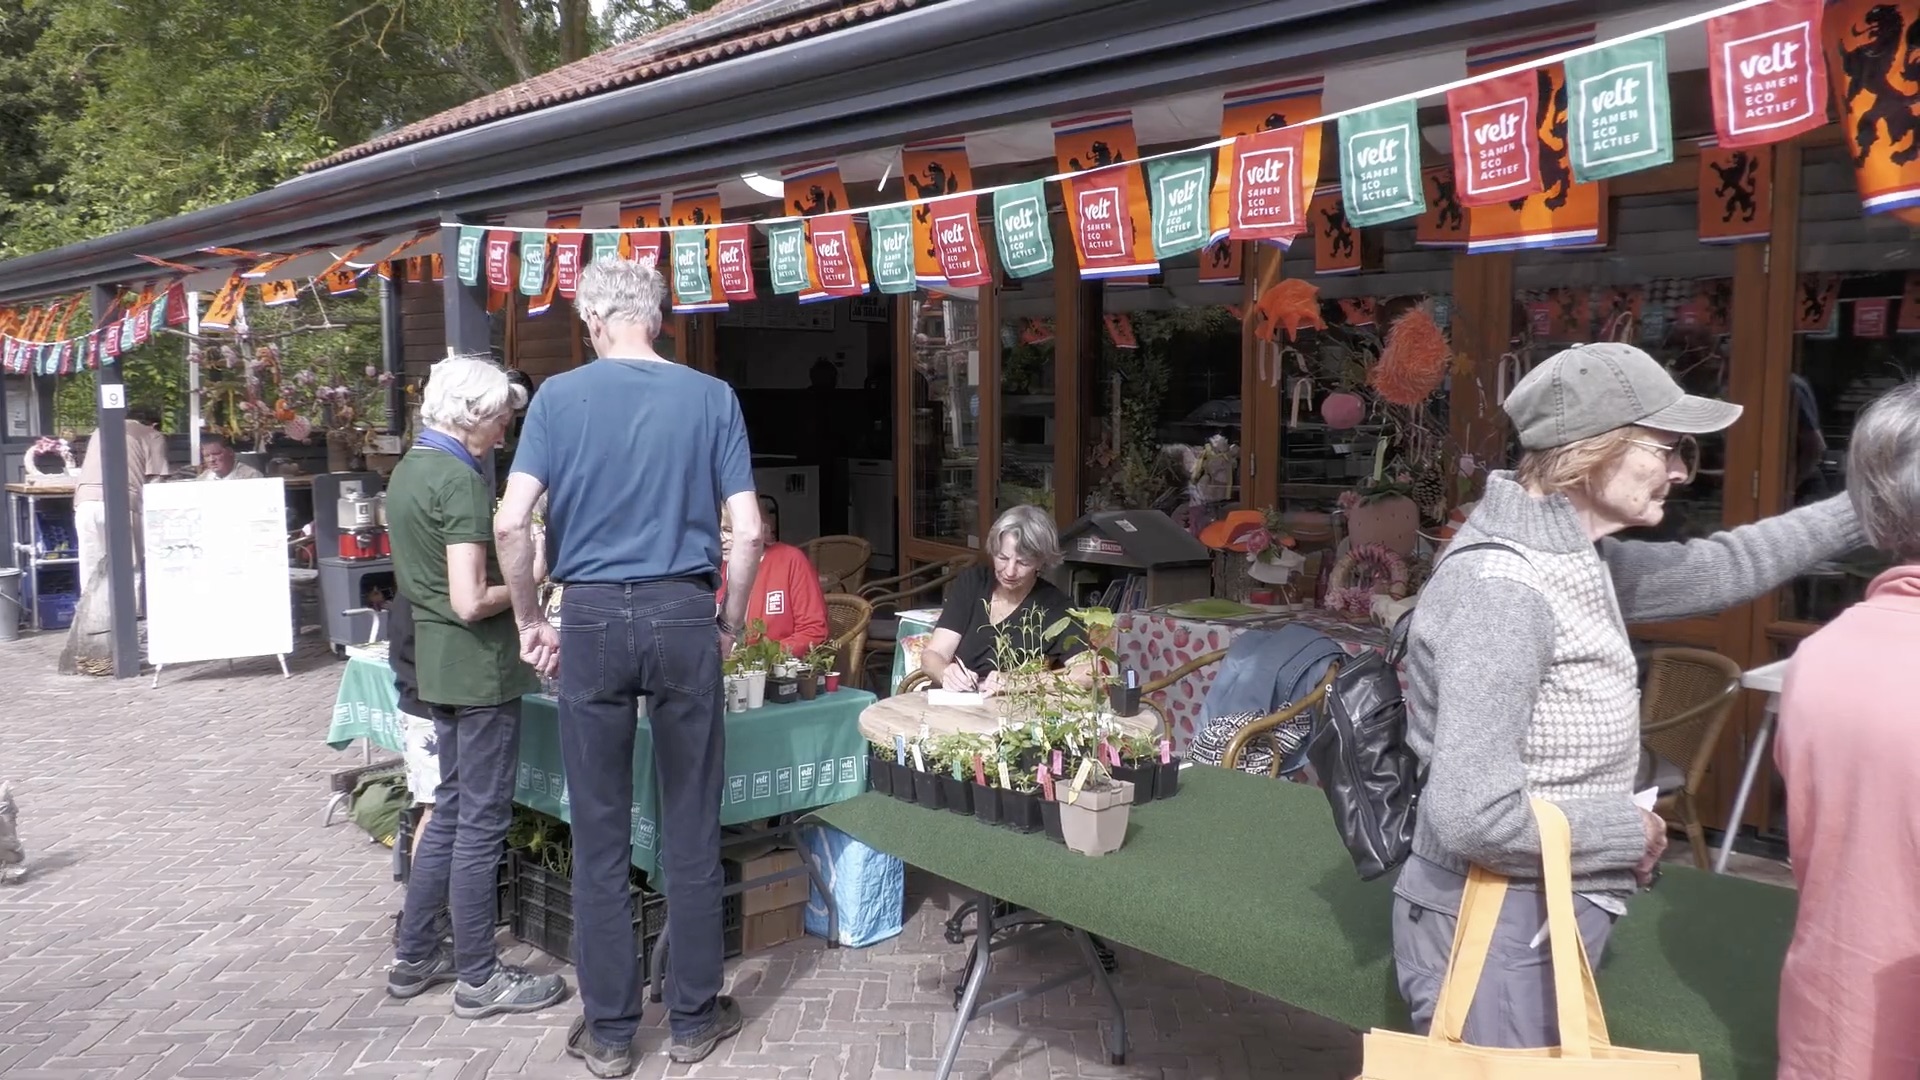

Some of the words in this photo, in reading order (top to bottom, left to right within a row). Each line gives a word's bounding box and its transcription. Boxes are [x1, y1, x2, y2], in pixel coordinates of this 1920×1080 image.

[1739, 42, 1801, 79] velt
[1743, 74, 1798, 94] SAMEN
[1592, 77, 1640, 114] velt
[1745, 92, 1775, 106] ECO
[1745, 98, 1798, 118] ACTIEF
[1591, 110, 1638, 128] SAMEN
[1474, 112, 1520, 145] velt
[1592, 127, 1617, 140] ECO
[1593, 132, 1640, 151] ACTIEF
[1357, 138, 1400, 168] velt
[1480, 142, 1516, 160] SAMEN
[1247, 158, 1284, 185] velt
[1480, 159, 1502, 170] ECO
[1480, 164, 1519, 181] ACTIEF
[1360, 166, 1398, 181] SAMEN
[1169, 180, 1198, 207] velt
[1247, 186, 1280, 198] SAMEN
[1362, 180, 1380, 192] ECO
[1362, 186, 1399, 202] ACTIEF
[1085, 197, 1111, 220] velt
[1168, 203, 1192, 218] SAMEN
[1248, 198, 1265, 207] ECO
[1004, 208, 1033, 232] velt
[1247, 206, 1281, 217] ACTIEF
[1087, 223, 1111, 231] SAMEN
[1166, 216, 1181, 226] ECO
[1166, 221, 1191, 235] ACTIEF
[883, 231, 905, 252] velt
[941, 223, 964, 245] velt
[1009, 231, 1034, 243] SAMEN
[778, 236, 796, 255] velt
[818, 238, 839, 257] velt
[1010, 243, 1024, 251] ECO
[1089, 240, 1113, 249] ACTIEF
[679, 248, 695, 266] velt
[720, 246, 739, 264] velt
[1011, 248, 1037, 259] ACTIEF
[109, 392, 118, 405] 9
